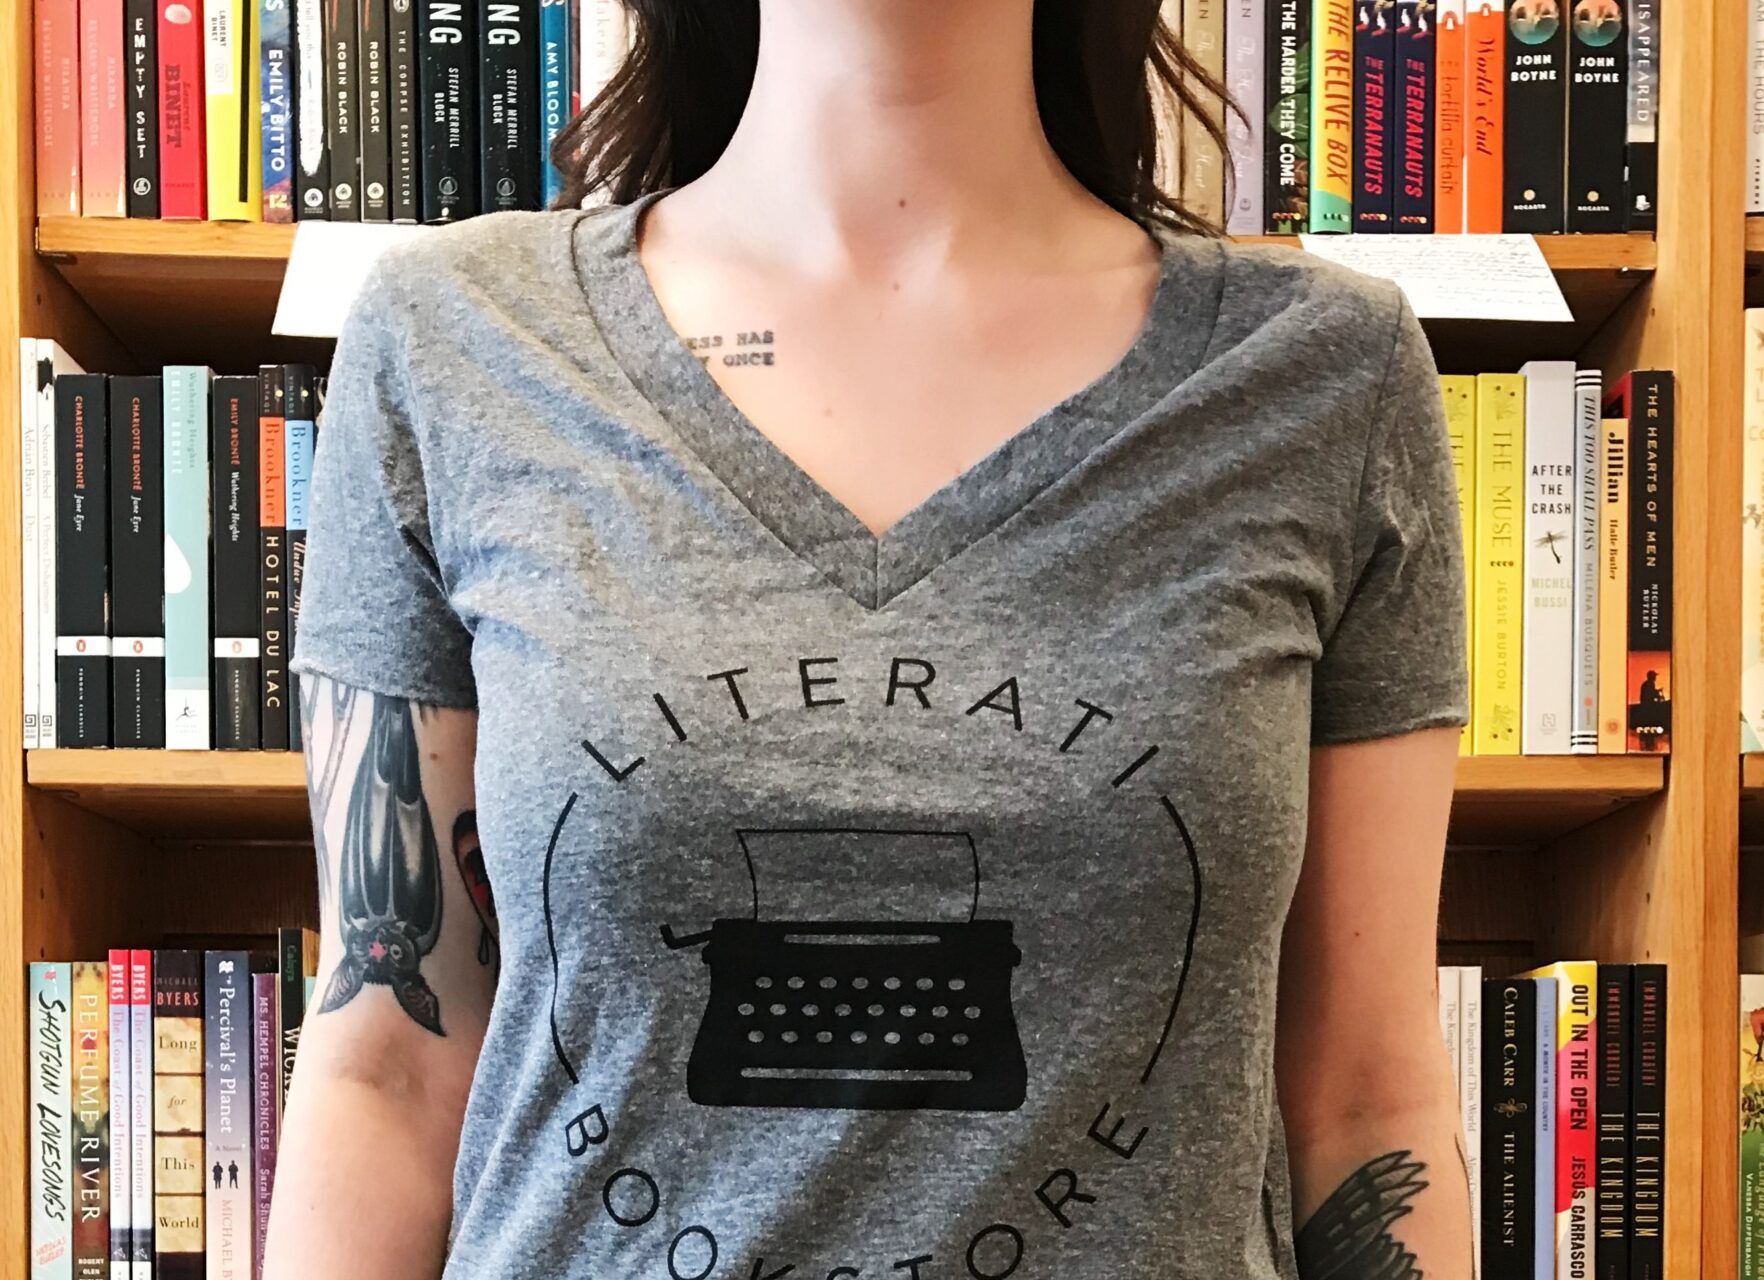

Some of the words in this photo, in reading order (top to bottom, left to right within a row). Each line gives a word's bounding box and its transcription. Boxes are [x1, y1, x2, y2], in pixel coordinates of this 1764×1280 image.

[1281, 1, 1296, 30] THE
[1327, 1, 1349, 40] THE
[134, 18, 146, 99] EMPTY
[369, 41, 379, 84] ROBIN
[398, 30, 406, 53] THE
[546, 42, 558, 74] AMY
[1516, 54, 1552, 66] JOHN
[1579, 57, 1615, 68] JOHN
[269, 49, 284, 107] EMILY
[337, 42, 347, 85] ROBIN
[449, 67, 459, 102] STEFAN
[1281, 36, 1296, 95] HARDER
[1475, 38, 1494, 108] World's
[1511, 69, 1557, 82] BOYNE
[1575, 72, 1619, 84] BOYNE
[165, 64, 182, 149] BINET
[399, 64, 407, 112] CORPSE
[434, 92, 445, 123] BLOCK
[507, 69, 517, 104] STEFAN
[1324, 49, 1350, 130] RELIVE
[338, 91, 348, 134] BLACK
[370, 91, 380, 133] BLACK
[449, 106, 459, 148] MERRILL
[492, 94, 503, 124] BLOCK
[507, 109, 518, 149] MERRILL
[547, 80, 559, 142] BLOOM
[1280, 98, 1296, 140] THEY
[136, 111, 146, 158] SET
[270, 113, 286, 172] BITTO
[1364, 73, 1385, 195] TERRANAUTS
[1405, 76, 1426, 197] TERRANAUTS
[1475, 116, 1493, 156] End
[400, 125, 410, 205] EXHIBITION
[1280, 143, 1295, 186] COME
[1327, 138, 1349, 185] BOX
[723, 352, 775, 367] ONCE
[75, 396, 84, 449] CHARLOTTE
[1648, 384, 1658, 418] THE
[131, 397, 141, 451] CHARLOTTE
[265, 423, 280, 524] Brookner
[1492, 433, 1512, 472] THE
[1532, 465, 1572, 477] AFTER
[1607, 432, 1624, 503] Jillian
[1647, 427, 1657, 492] HEARTS
[290, 426, 307, 526] Brookner
[1541, 484, 1562, 496] THE
[73, 514, 84, 532] Eyre
[74, 495, 84, 513] Jane
[130, 496, 142, 514] Jane
[130, 516, 141, 533] Eyre
[1491, 486, 1512, 548] MUSE
[1532, 503, 1571, 515] CRASH
[1647, 501, 1657, 522] OF
[1646, 531, 1656, 567] MEN
[265, 536, 279, 614] HOTEL
[1531, 578, 1572, 589] MICHEL
[1496, 579, 1506, 624] JESSIE
[266, 631, 279, 656] DU
[1496, 633, 1506, 690] BURTON
[266, 669, 280, 708] LAC
[581, 657, 1159, 788] LITERATI
[111, 964, 124, 1001] BYERS
[133, 964, 145, 1000] BYERS
[157, 992, 199, 1006] BYERS
[1571, 984, 1588, 1016] OUT
[219, 988, 236, 1072] Percival's
[1504, 987, 1518, 1037] CALEB
[1571, 1024, 1587, 1037] IN
[38, 990, 66, 1095] SHOTGUN
[79, 994, 99, 1121] PERFUME
[159, 1036, 197, 1050] Long
[259, 1020, 268, 1069] HEMPEL
[1503, 1043, 1518, 1086] CARR
[1571, 1049, 1587, 1080] THE
[168, 1095, 187, 1108] for
[220, 1079, 236, 1134] Planet
[259, 1072, 269, 1150] CHRONICLES
[1570, 1087, 1588, 1130] OPEN
[1600, 1112, 1624, 1141] THE
[1636, 1112, 1659, 1141] THE
[39, 1103, 65, 1222] LOVESONGS
[161, 1157, 195, 1171] This
[1504, 1132, 1515, 1165] THE
[82, 1137, 100, 1222] RIVER
[1571, 1156, 1589, 1199] JESÚS
[1600, 1158, 1624, 1238] KINGDOM
[1635, 1157, 1659, 1237] KINGDOM
[1746, 1173, 1754, 1212] VANESSA
[159, 1215, 199, 1230] World
[1503, 1172, 1515, 1247] ALIENIST
[221, 1200, 233, 1265] MICHAEL
[1570, 1205, 1585, 1278] CARRASCO
[1745, 1216, 1753, 1276] DIFFENBAUGH
